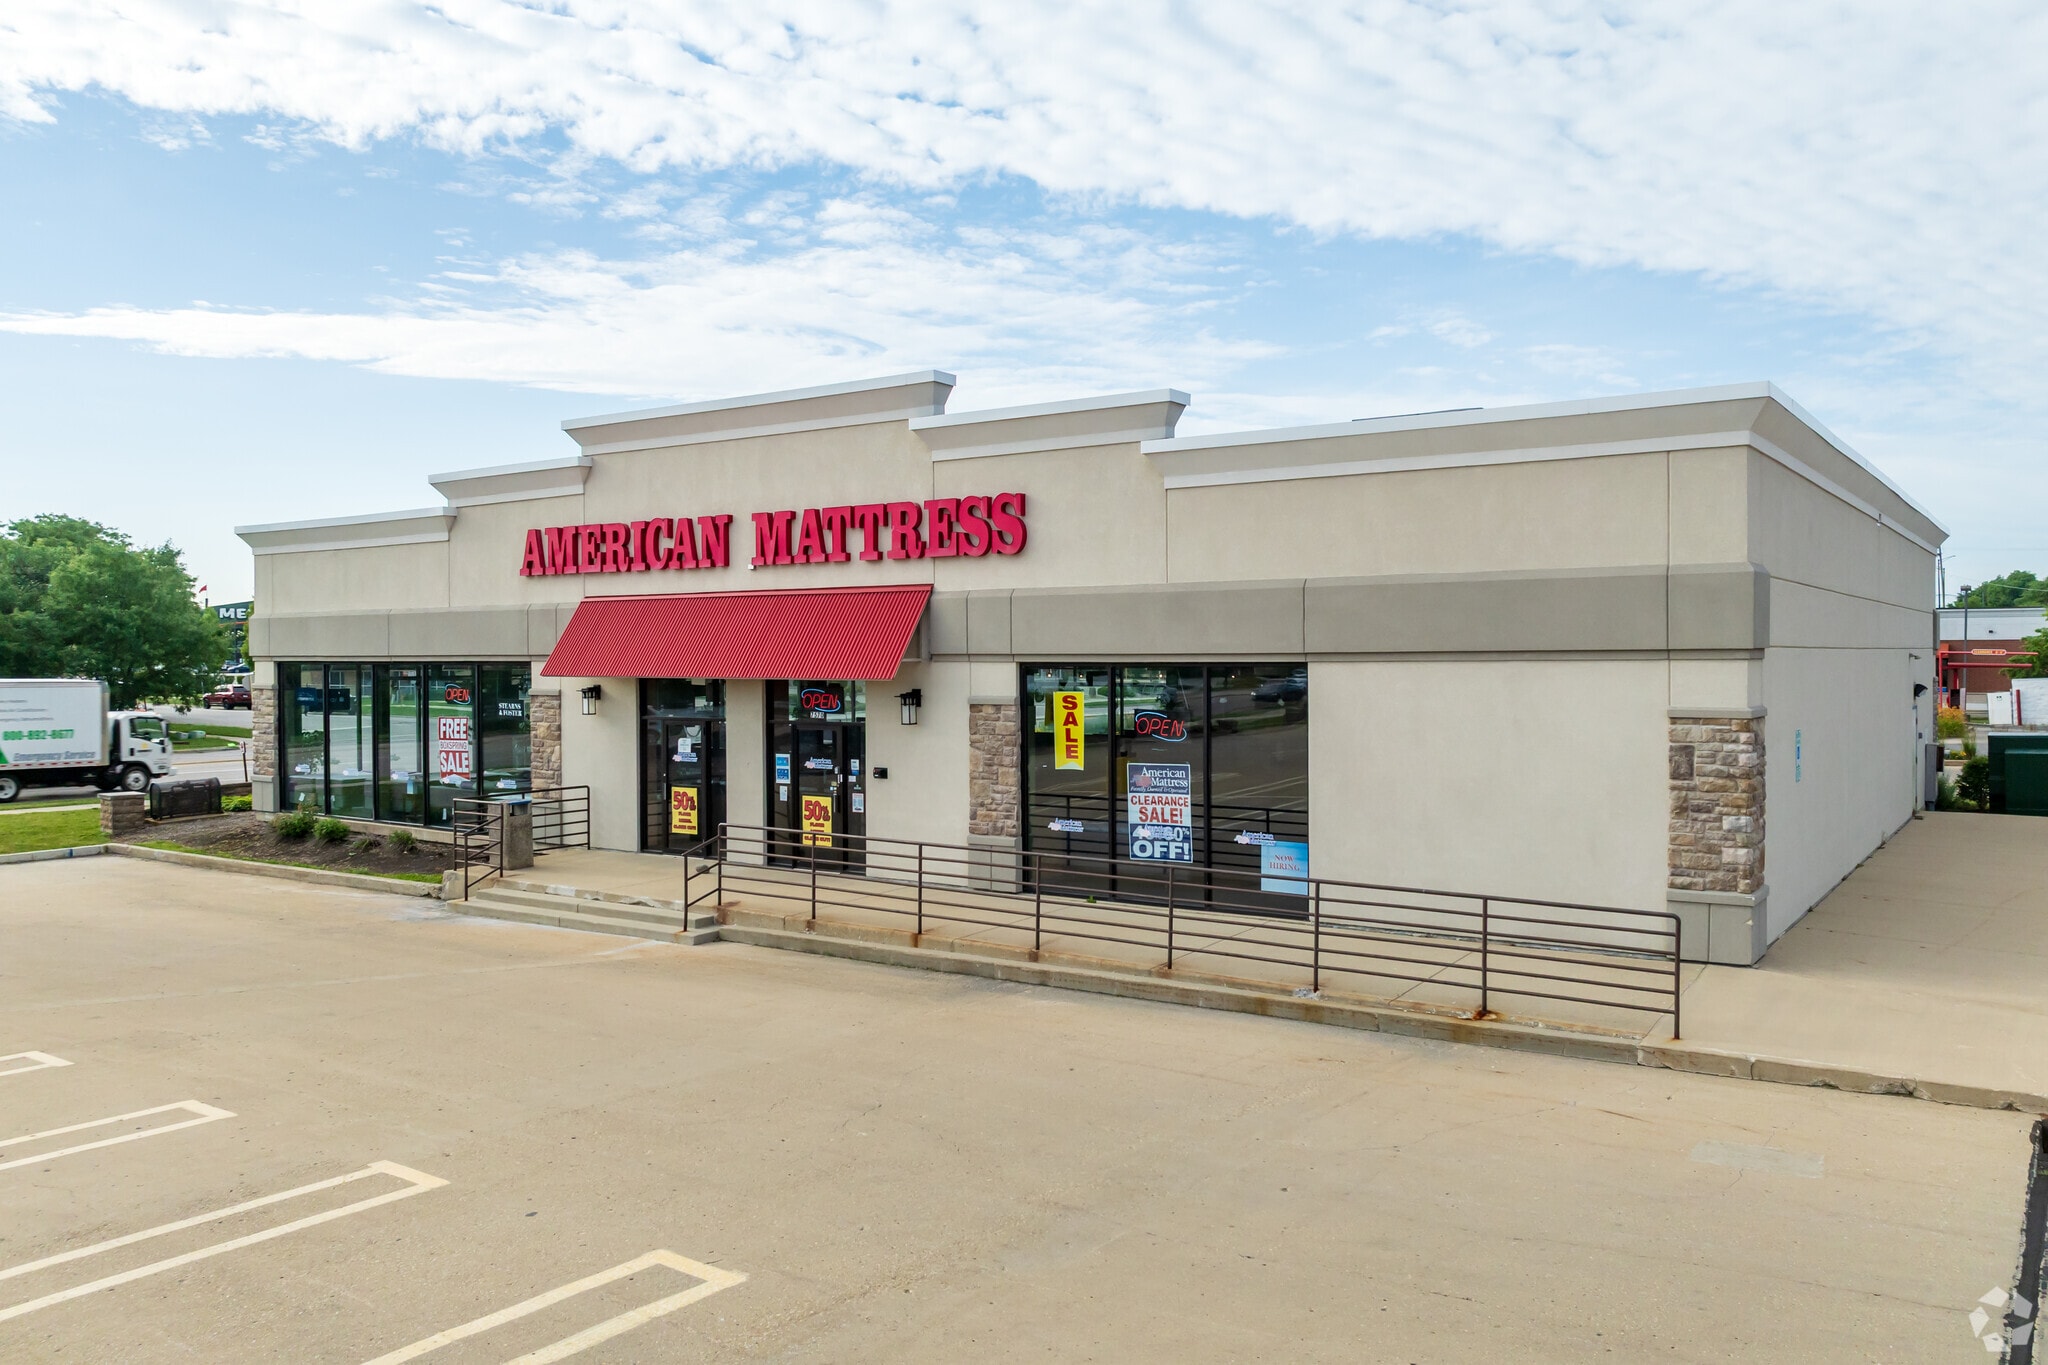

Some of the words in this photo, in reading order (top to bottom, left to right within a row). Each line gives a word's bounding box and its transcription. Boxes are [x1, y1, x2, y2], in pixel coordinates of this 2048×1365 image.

[520, 514, 733, 576] AMERICAN
[752, 493, 1027, 567] MATTRESS
[219, 607, 250, 619] ME
[445, 688, 470, 701] OPEN
[803, 693, 839, 709] OPEN
[440, 718, 467, 739] FREE
[1062, 695, 1079, 759] SALE
[1136, 717, 1184, 737] OPEN
[440, 751, 469, 773] SALE
[1141, 766, 1186, 778] American
[1151, 777, 1188, 787] Mattress
[1130, 795, 1189, 807] CLEARANCE
[1138, 806, 1183, 824] SALE!
[1133, 840, 1190, 860] OFF!
[1274, 854, 1294, 862] NOW
[1269, 862, 1300, 871] HIRING
